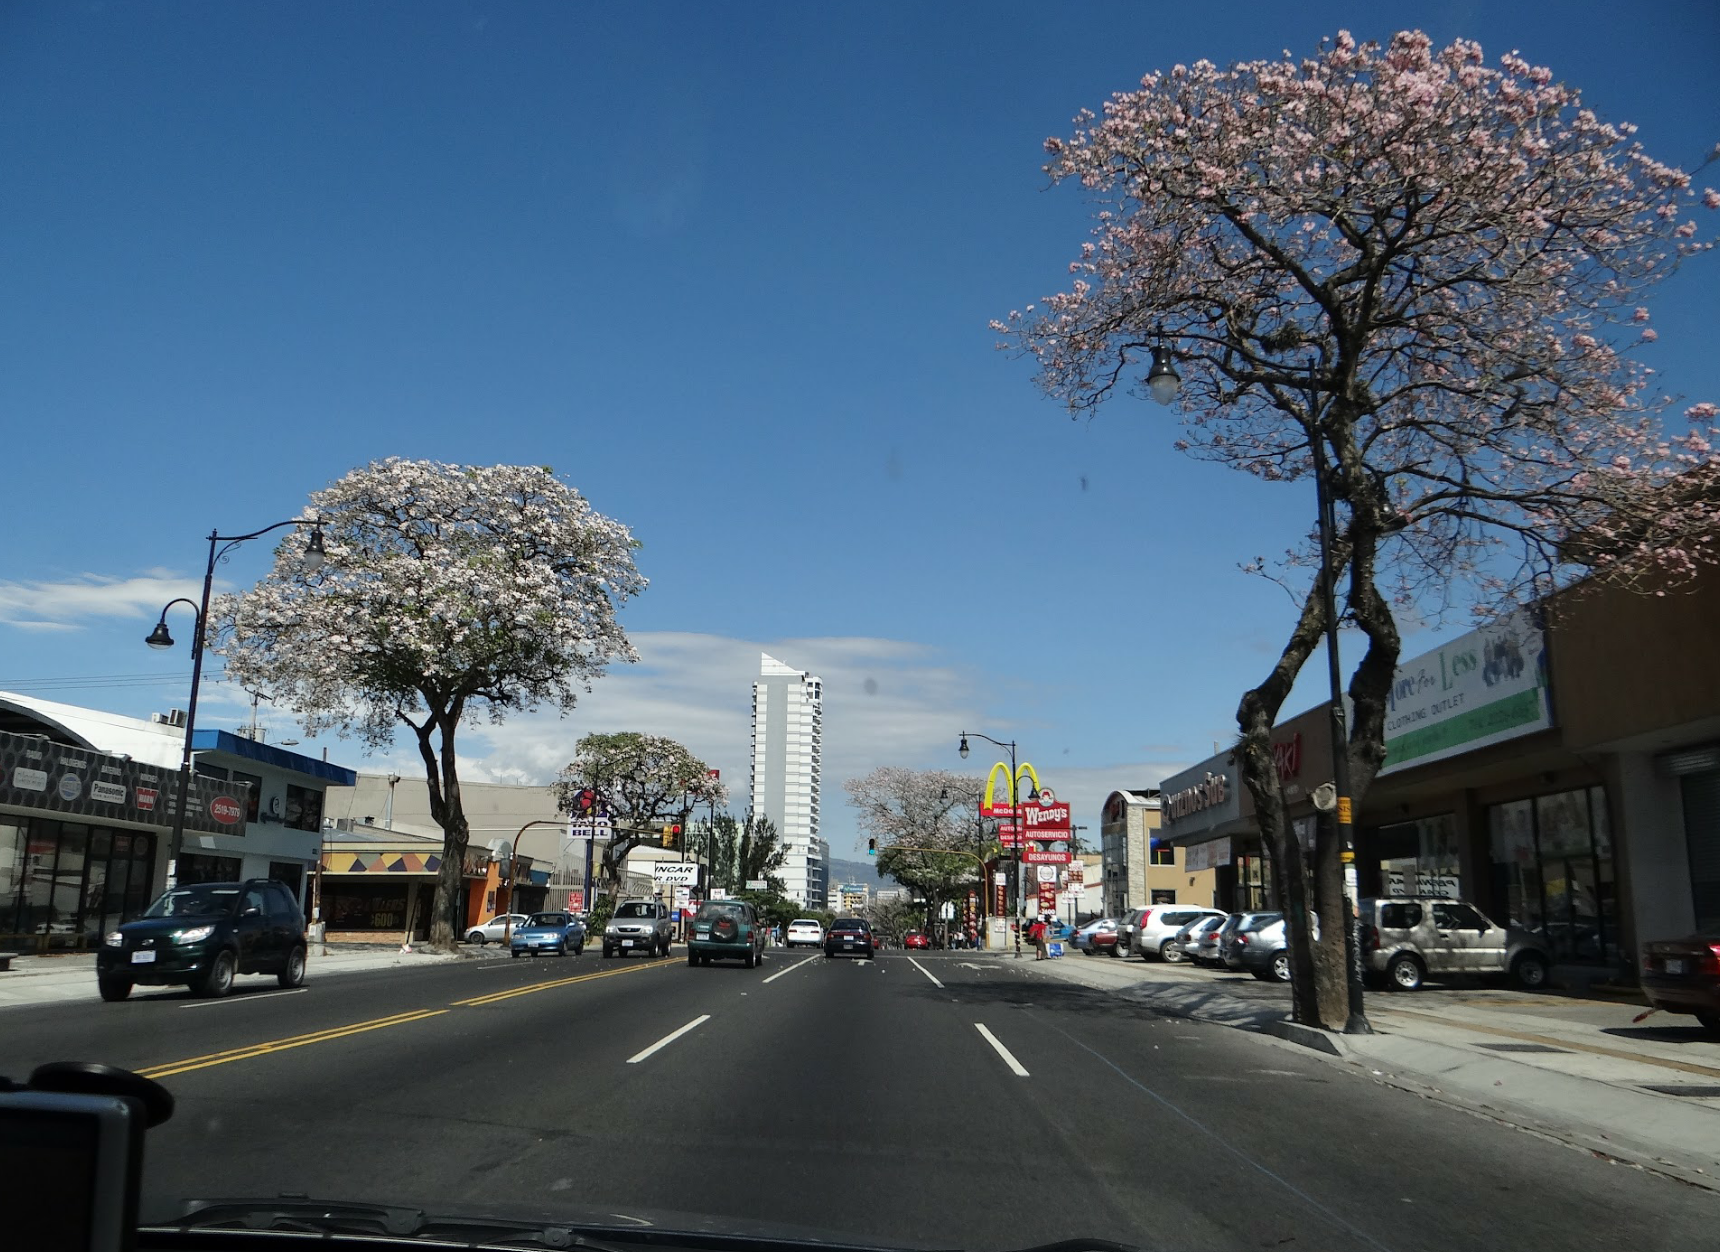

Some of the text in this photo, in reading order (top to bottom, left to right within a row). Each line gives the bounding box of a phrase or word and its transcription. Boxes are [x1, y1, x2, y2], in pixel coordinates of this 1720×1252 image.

[1387, 707, 1428, 731] CLOTHING
[1430, 693, 1465, 715] OUTLET
[94, 783, 124, 797] Panasonic
[214, 803, 240, 818] 2519-7979
[571, 820, 608, 829] TAO
[1025, 831, 1068, 839] AUTOSERVICIO
[1028, 853, 1066, 861] DESAYUNOS
